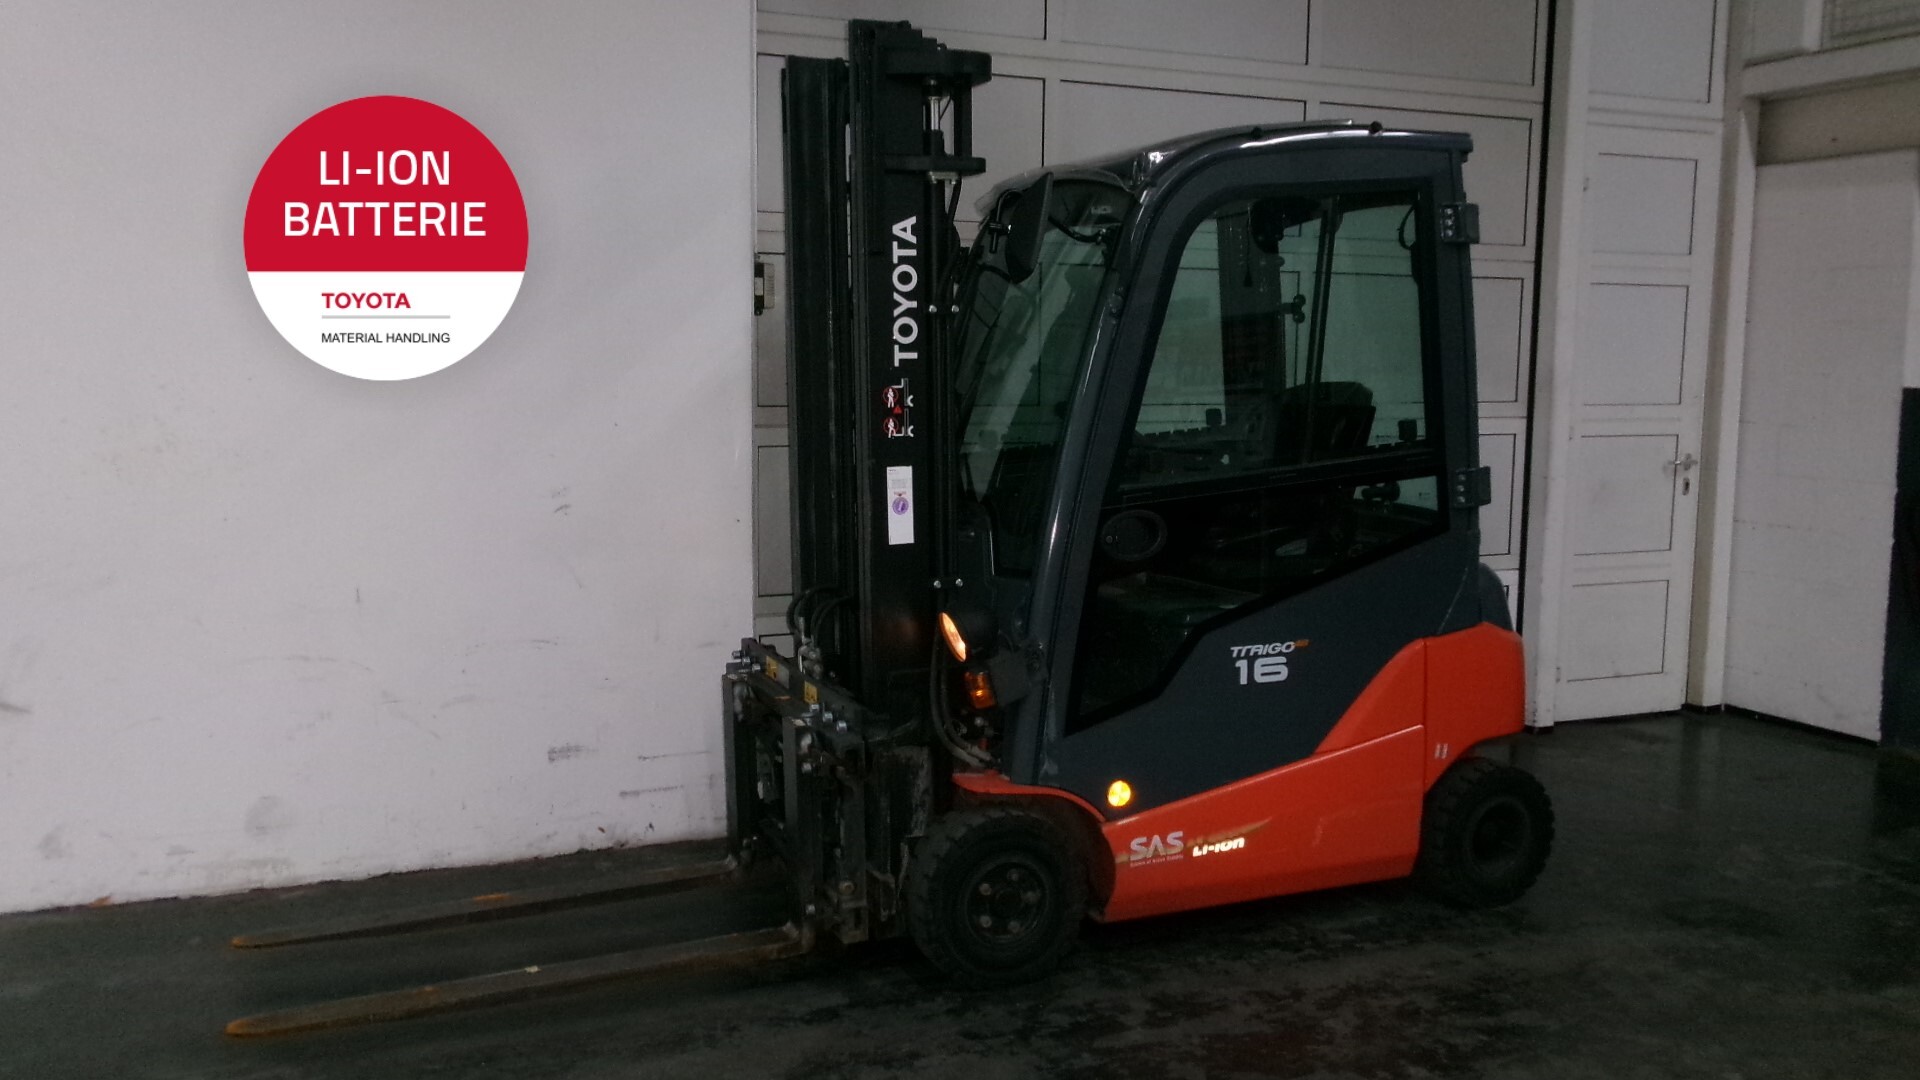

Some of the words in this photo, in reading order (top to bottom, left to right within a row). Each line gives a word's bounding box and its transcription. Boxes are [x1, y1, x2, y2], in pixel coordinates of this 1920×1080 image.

[892, 215, 918, 367] TOYOTA
[1235, 655, 1289, 685] 16
[1130, 831, 1184, 861] SAS
